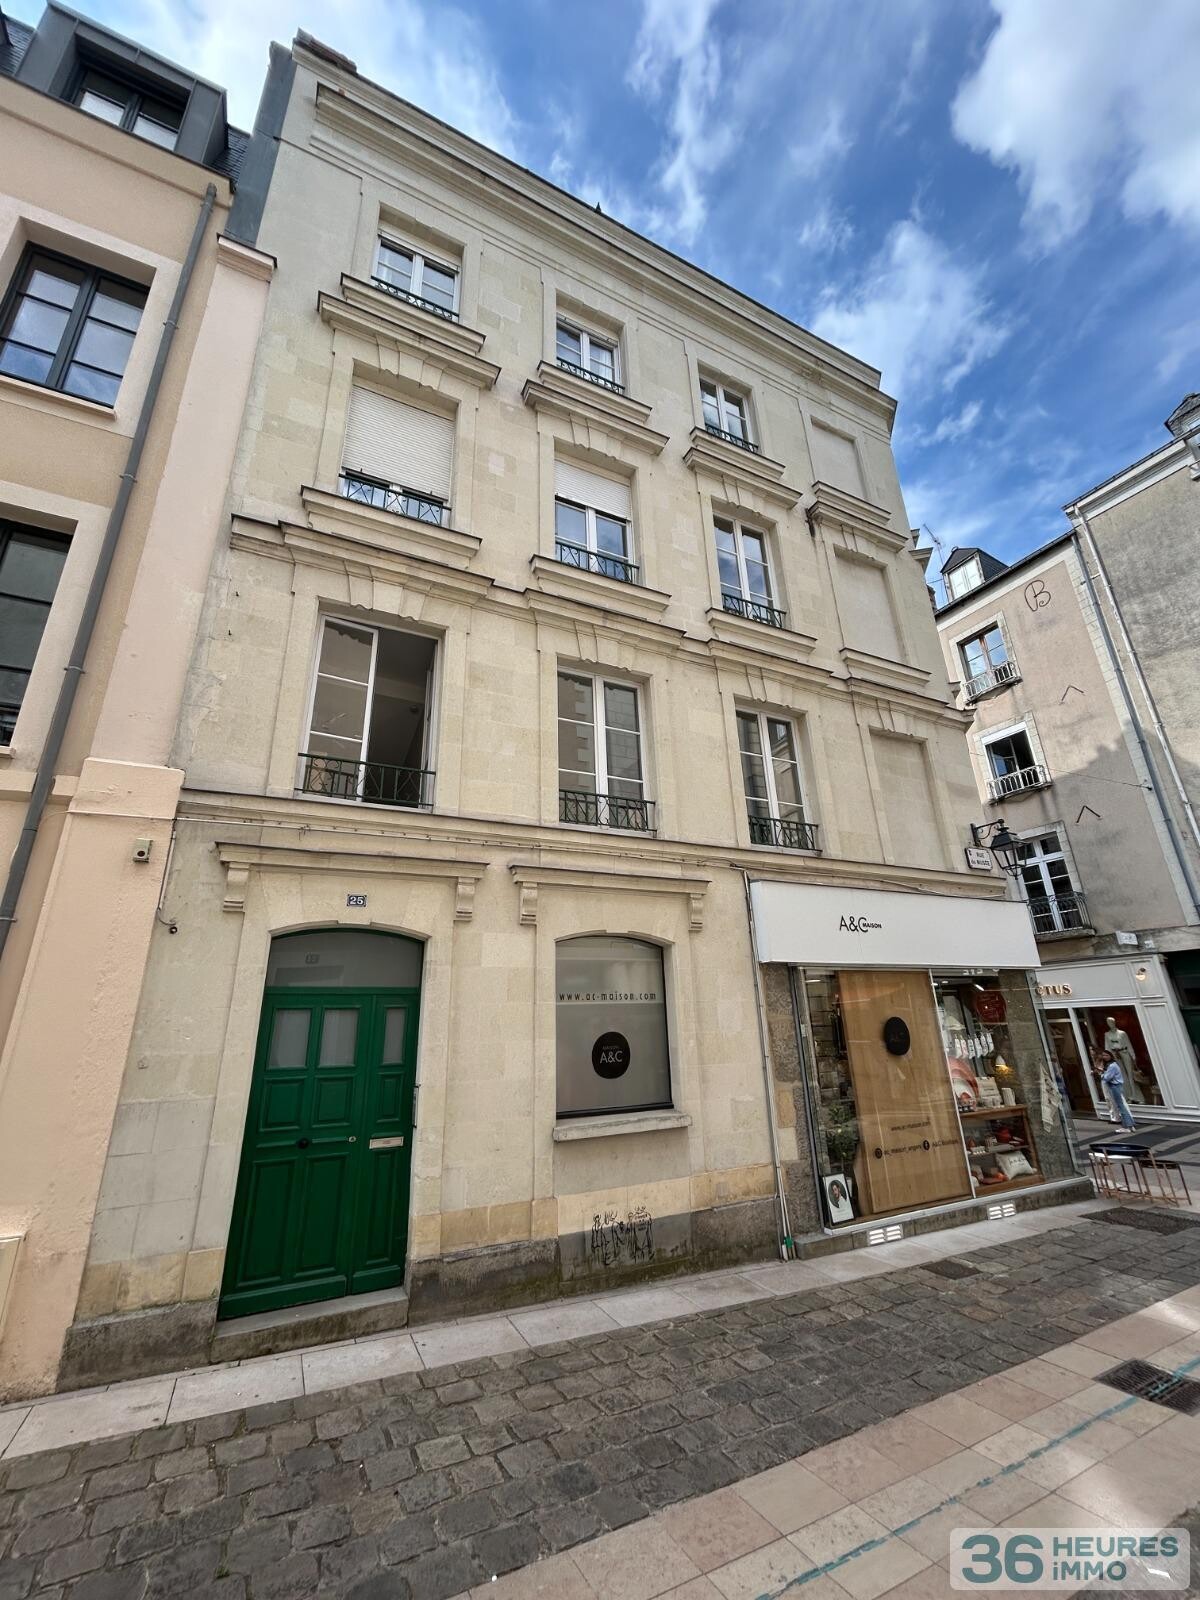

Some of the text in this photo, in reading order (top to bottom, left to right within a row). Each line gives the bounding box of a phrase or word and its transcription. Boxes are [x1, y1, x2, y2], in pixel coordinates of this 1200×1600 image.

[350, 896, 364, 905] 25
[839, 915, 869, 933] A&C
[559, 991, 656, 1000] www.ac-maison.com
[600, 1050, 623, 1063] A&C
